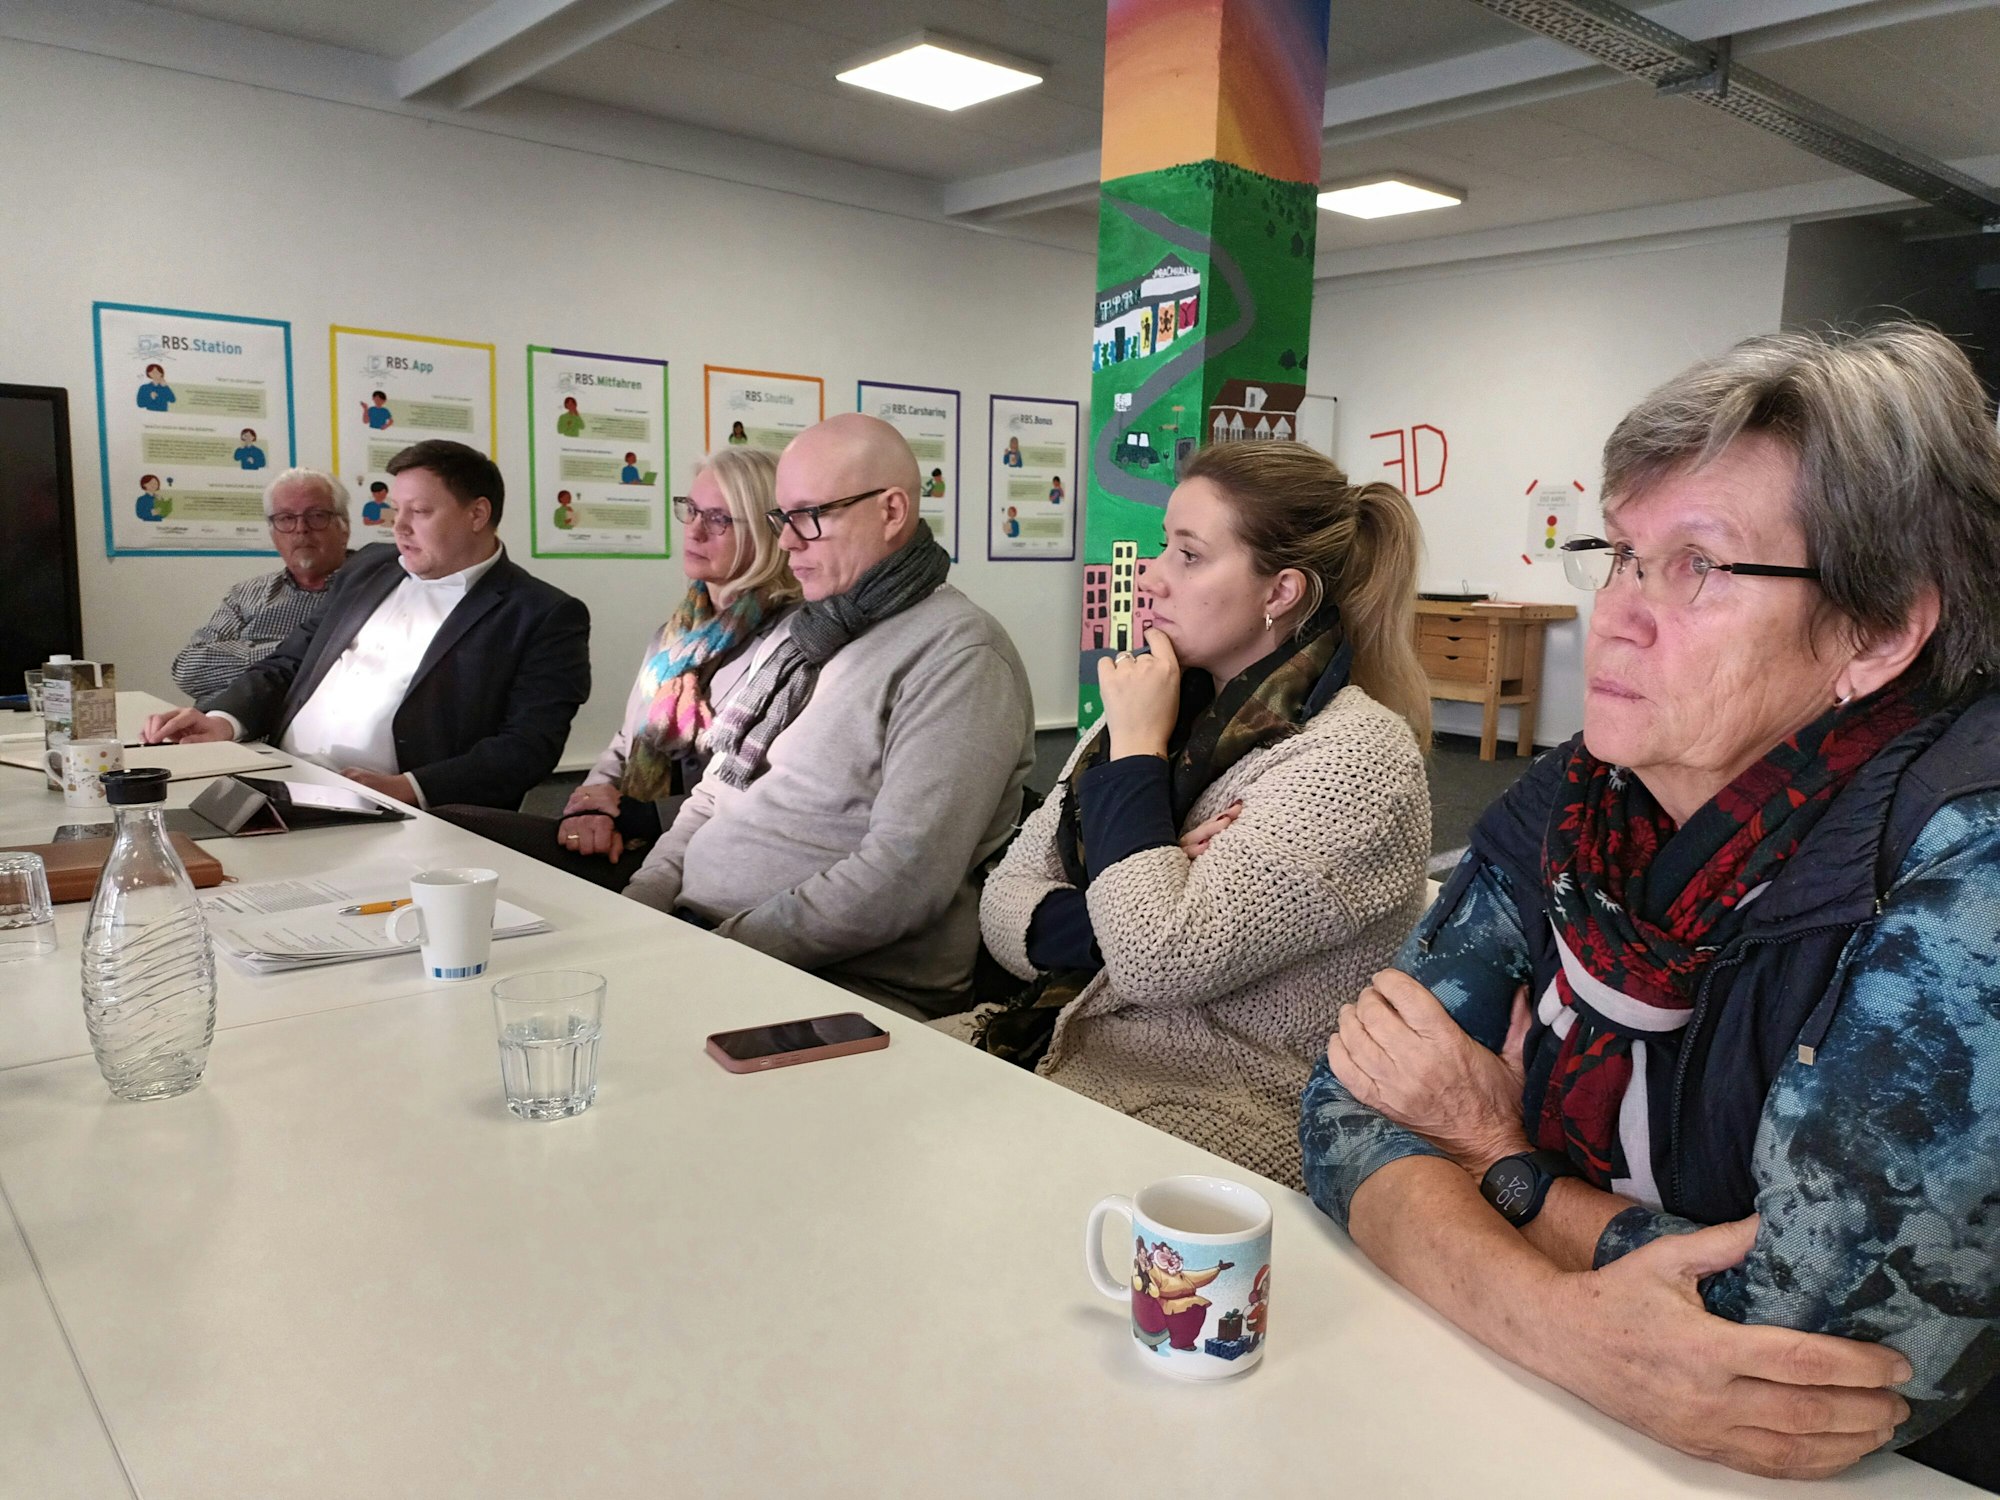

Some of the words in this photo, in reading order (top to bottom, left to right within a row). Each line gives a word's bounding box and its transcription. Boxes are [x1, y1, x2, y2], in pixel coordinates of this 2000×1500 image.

[161, 335, 243, 355] RBS.Station
[386, 356, 434, 374] RBS.App
[575, 373, 642, 390] RBS.Mitfahren
[892, 403, 946, 419] RBS.Carsharing
[1508, 1175, 1529, 1198] 24
[1496, 1188, 1515, 1211] 10
